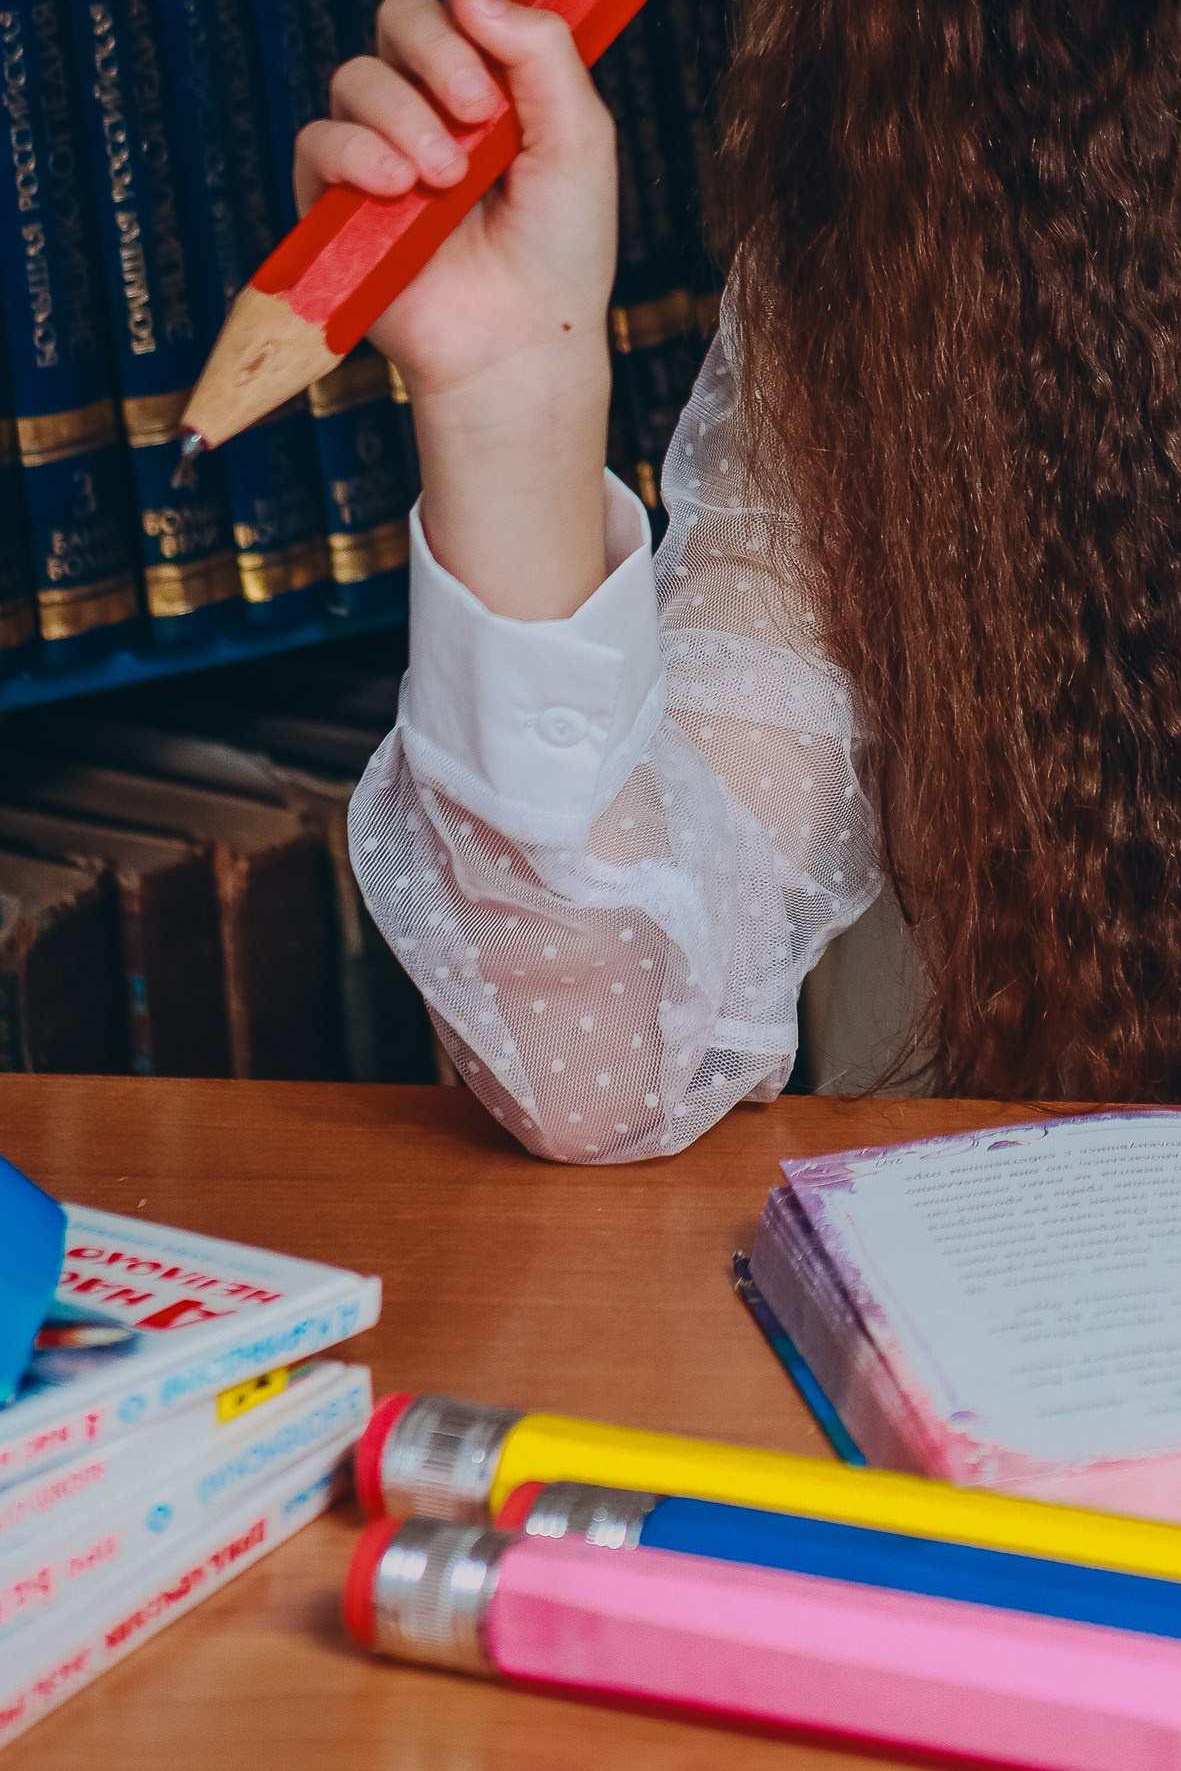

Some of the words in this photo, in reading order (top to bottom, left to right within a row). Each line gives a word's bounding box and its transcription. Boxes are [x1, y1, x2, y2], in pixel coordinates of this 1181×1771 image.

[0, 10, 40, 211] РОССИЙСКАЯ
[31, 0, 95, 356] ЭНЦИКЛОПЕДИЯ
[88, 3, 133, 203] РОССИЙСКАЯ
[21, 223, 59, 367] БОЛЬШАЯ
[114, 210, 157, 356] БОЛЬШАЯ
[66, 1246, 285, 1307] НЕПЛОХО
